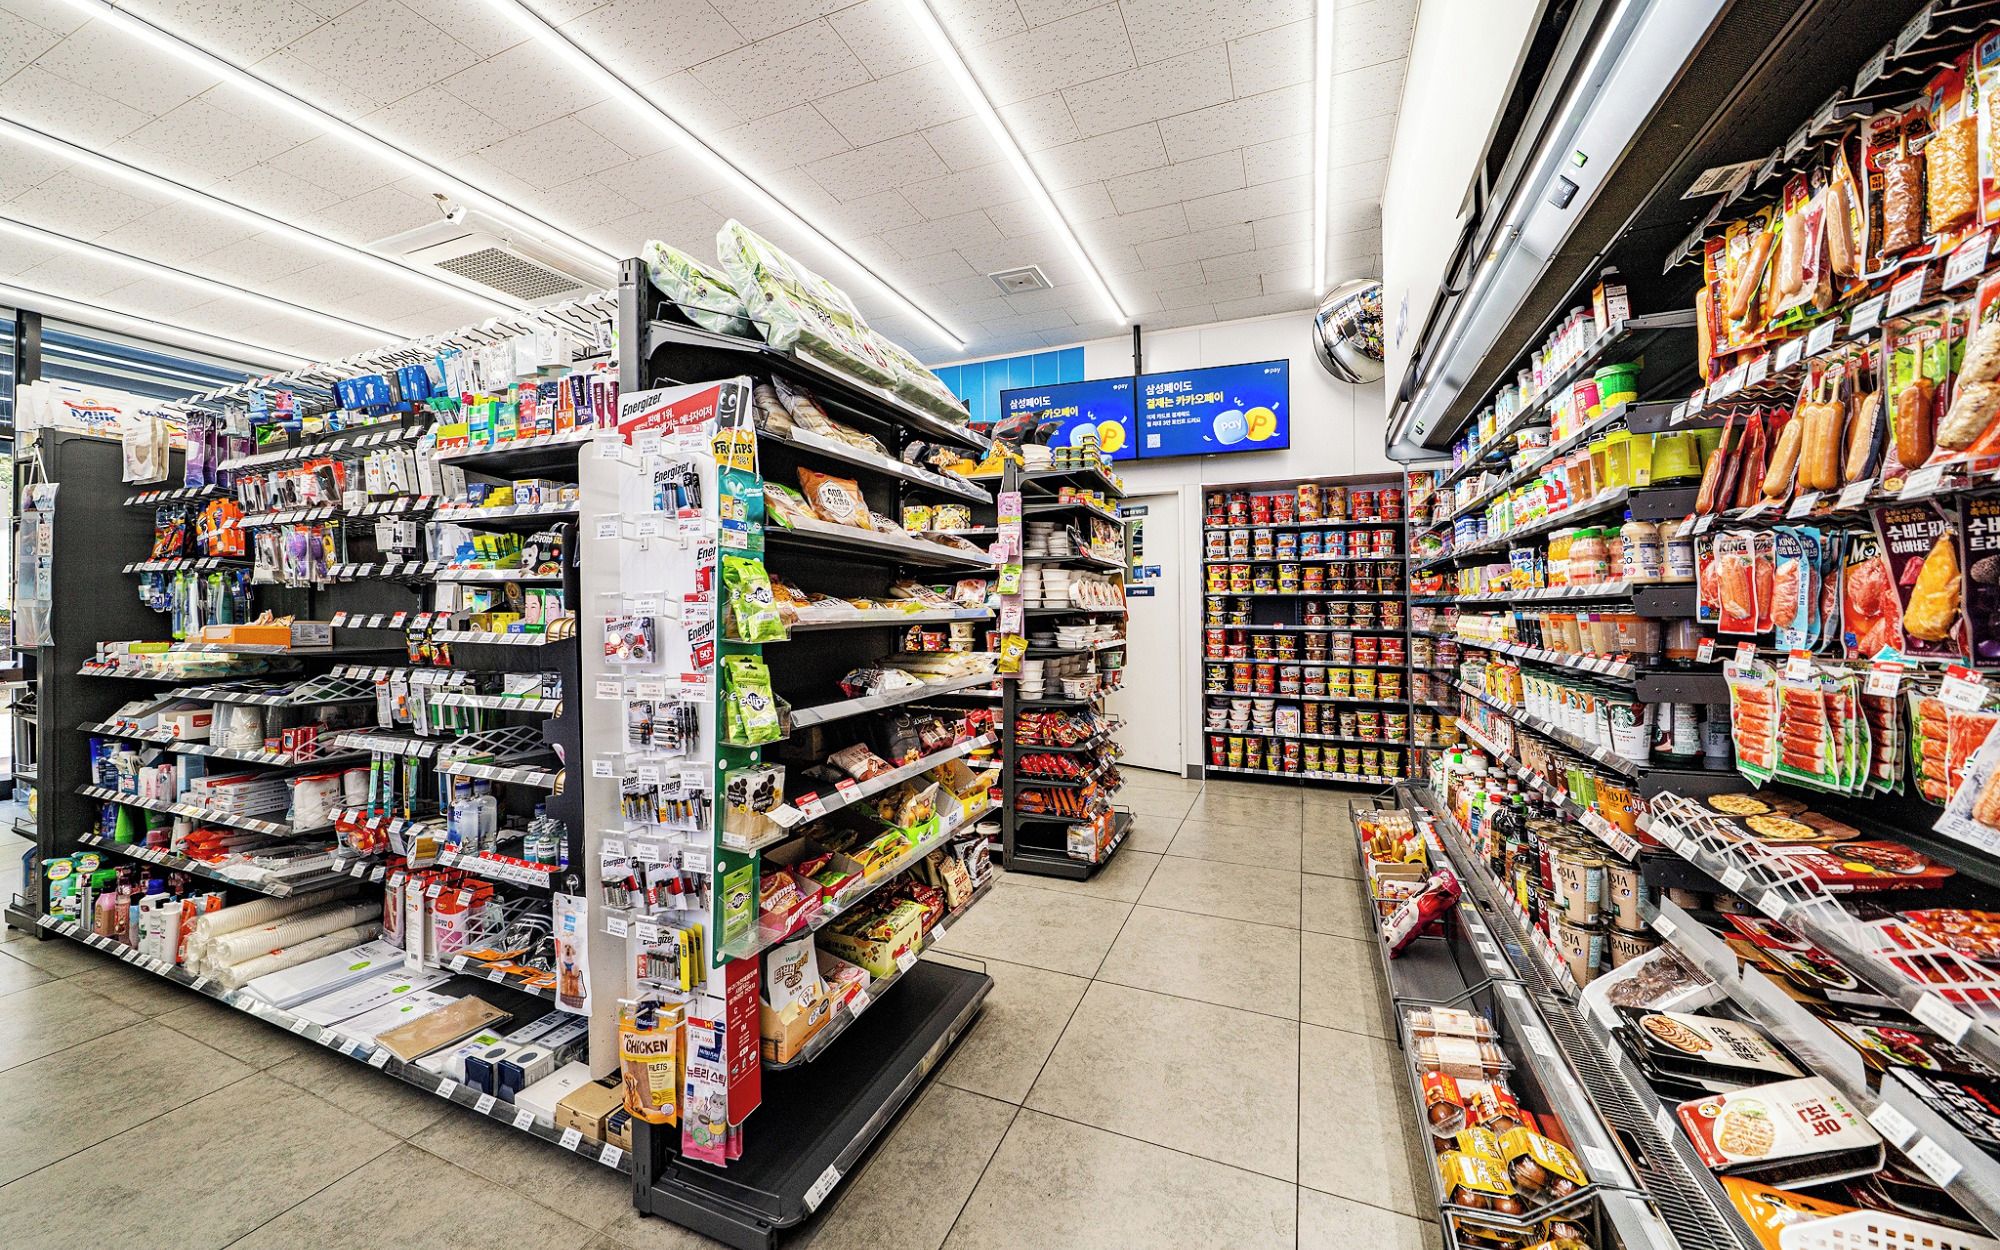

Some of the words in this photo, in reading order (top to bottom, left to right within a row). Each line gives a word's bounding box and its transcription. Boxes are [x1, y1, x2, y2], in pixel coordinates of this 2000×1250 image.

[1270, 367, 1281, 375] pay
[1145, 381, 1193, 396] 삼성페이도
[621, 392, 663, 418] Energizer
[1009, 396, 1051, 410] 삼성페이도
[1146, 396, 1174, 410] 결제는
[1175, 391, 1224, 407] 카카오페이
[71, 407, 117, 423] Milk
[680, 405, 713, 424] 에너자이저
[654, 462, 690, 484] Energizer
[736, 522, 747, 531] 2+1
[1886, 522, 1927, 541] 수비드
[1719, 543, 1747, 553] KING
[1779, 537, 1796, 546] KING
[697, 593, 709, 601] 2+1
[606, 620, 634, 634] Energizer
[695, 675, 707, 683] 2+1
[1964, 671, 1982, 684] 2+1
[602, 857, 627, 869] Energizer
[704, 1020, 714, 1029] 1+1
[686, 1066, 709, 1079] 뉴트리
[710, 1073, 727, 1087] 스틱
